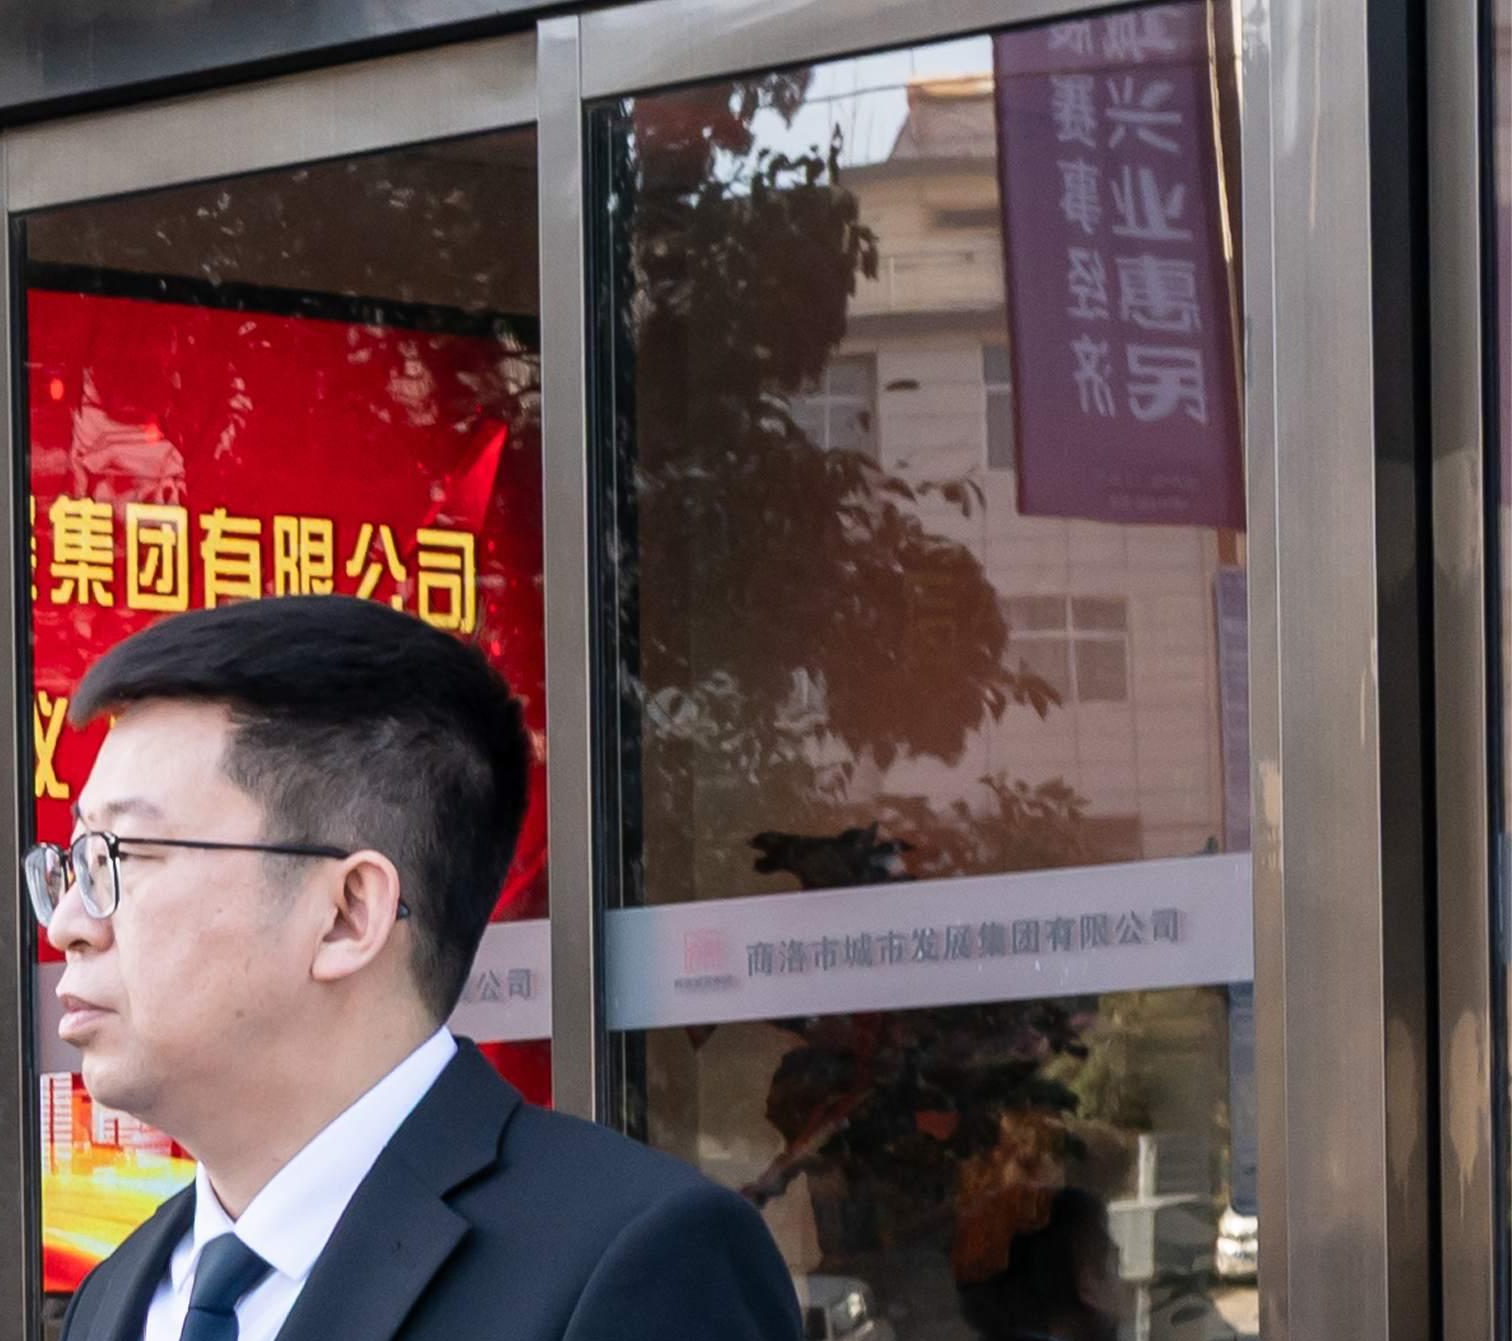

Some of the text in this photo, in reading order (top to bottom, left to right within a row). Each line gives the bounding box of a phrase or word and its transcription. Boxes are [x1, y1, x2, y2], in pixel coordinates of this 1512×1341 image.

[746, 907, 1181, 978] 商洛市城市发展集团有限公司
